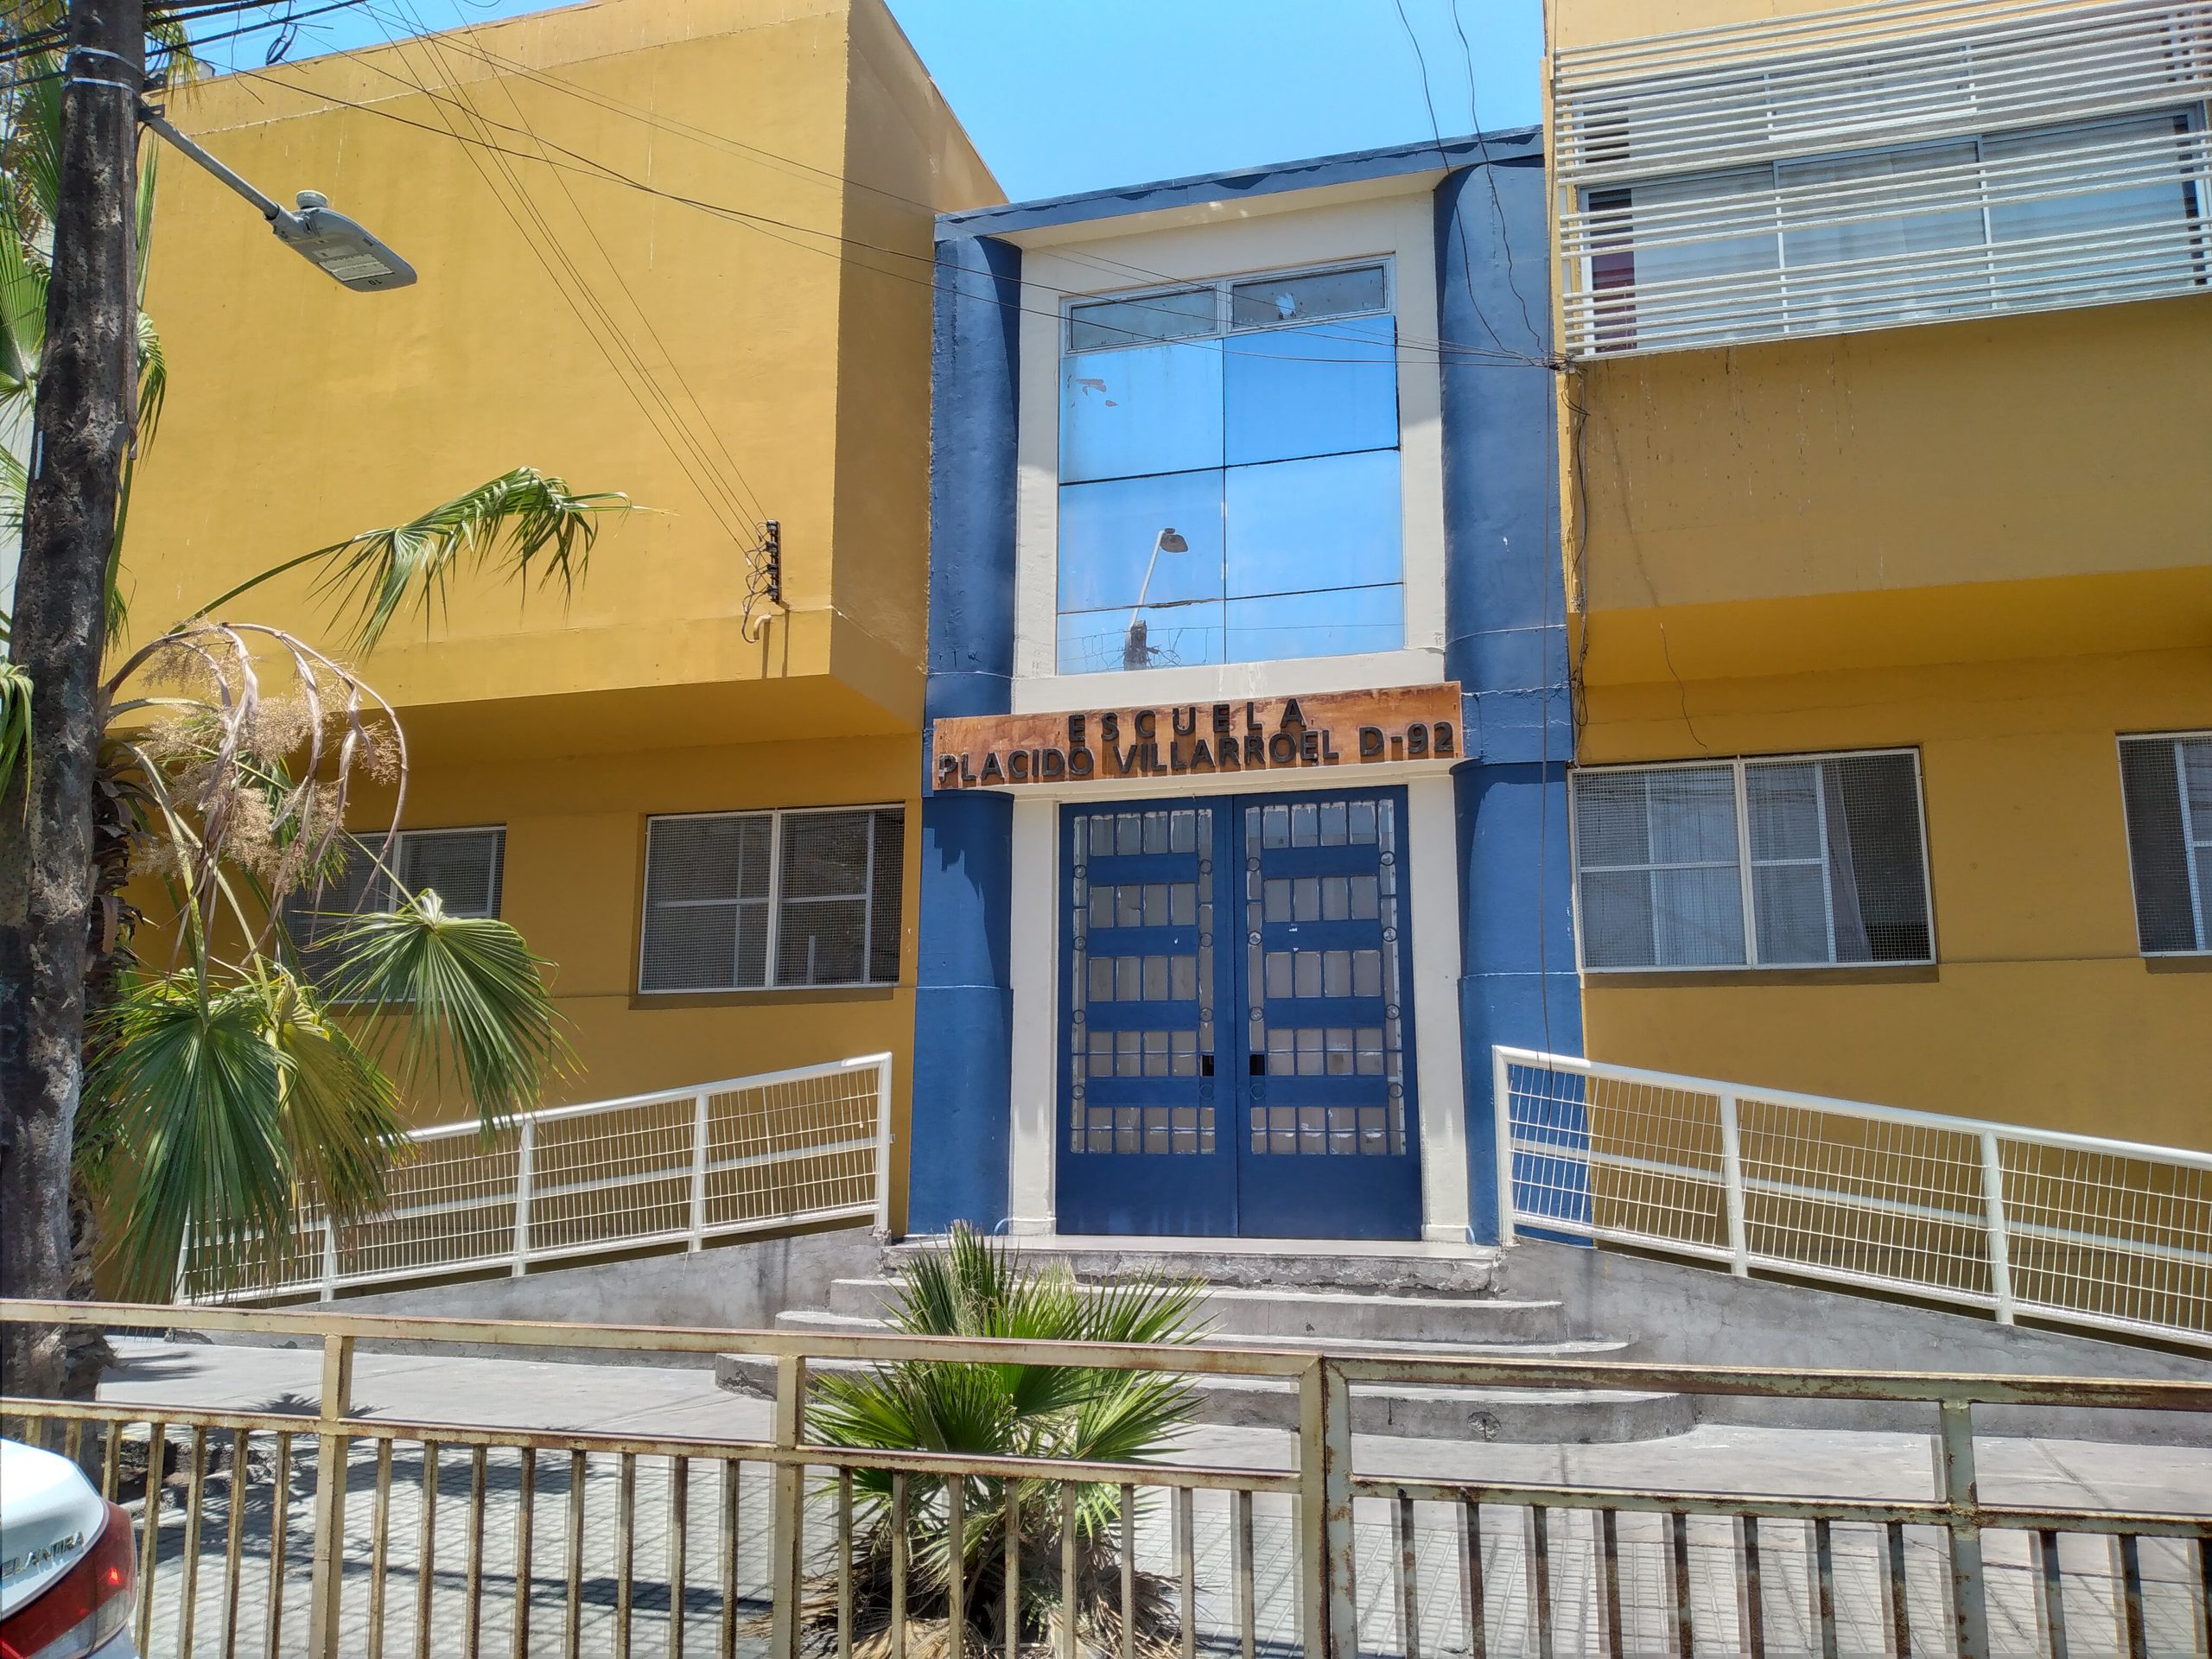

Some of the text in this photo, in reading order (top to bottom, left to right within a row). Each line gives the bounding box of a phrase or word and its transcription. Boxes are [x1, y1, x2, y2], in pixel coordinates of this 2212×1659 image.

[1068, 698, 1307, 743] ESCUELA
[938, 721, 1454, 780] PLACIDO VILLARROEL D-92
